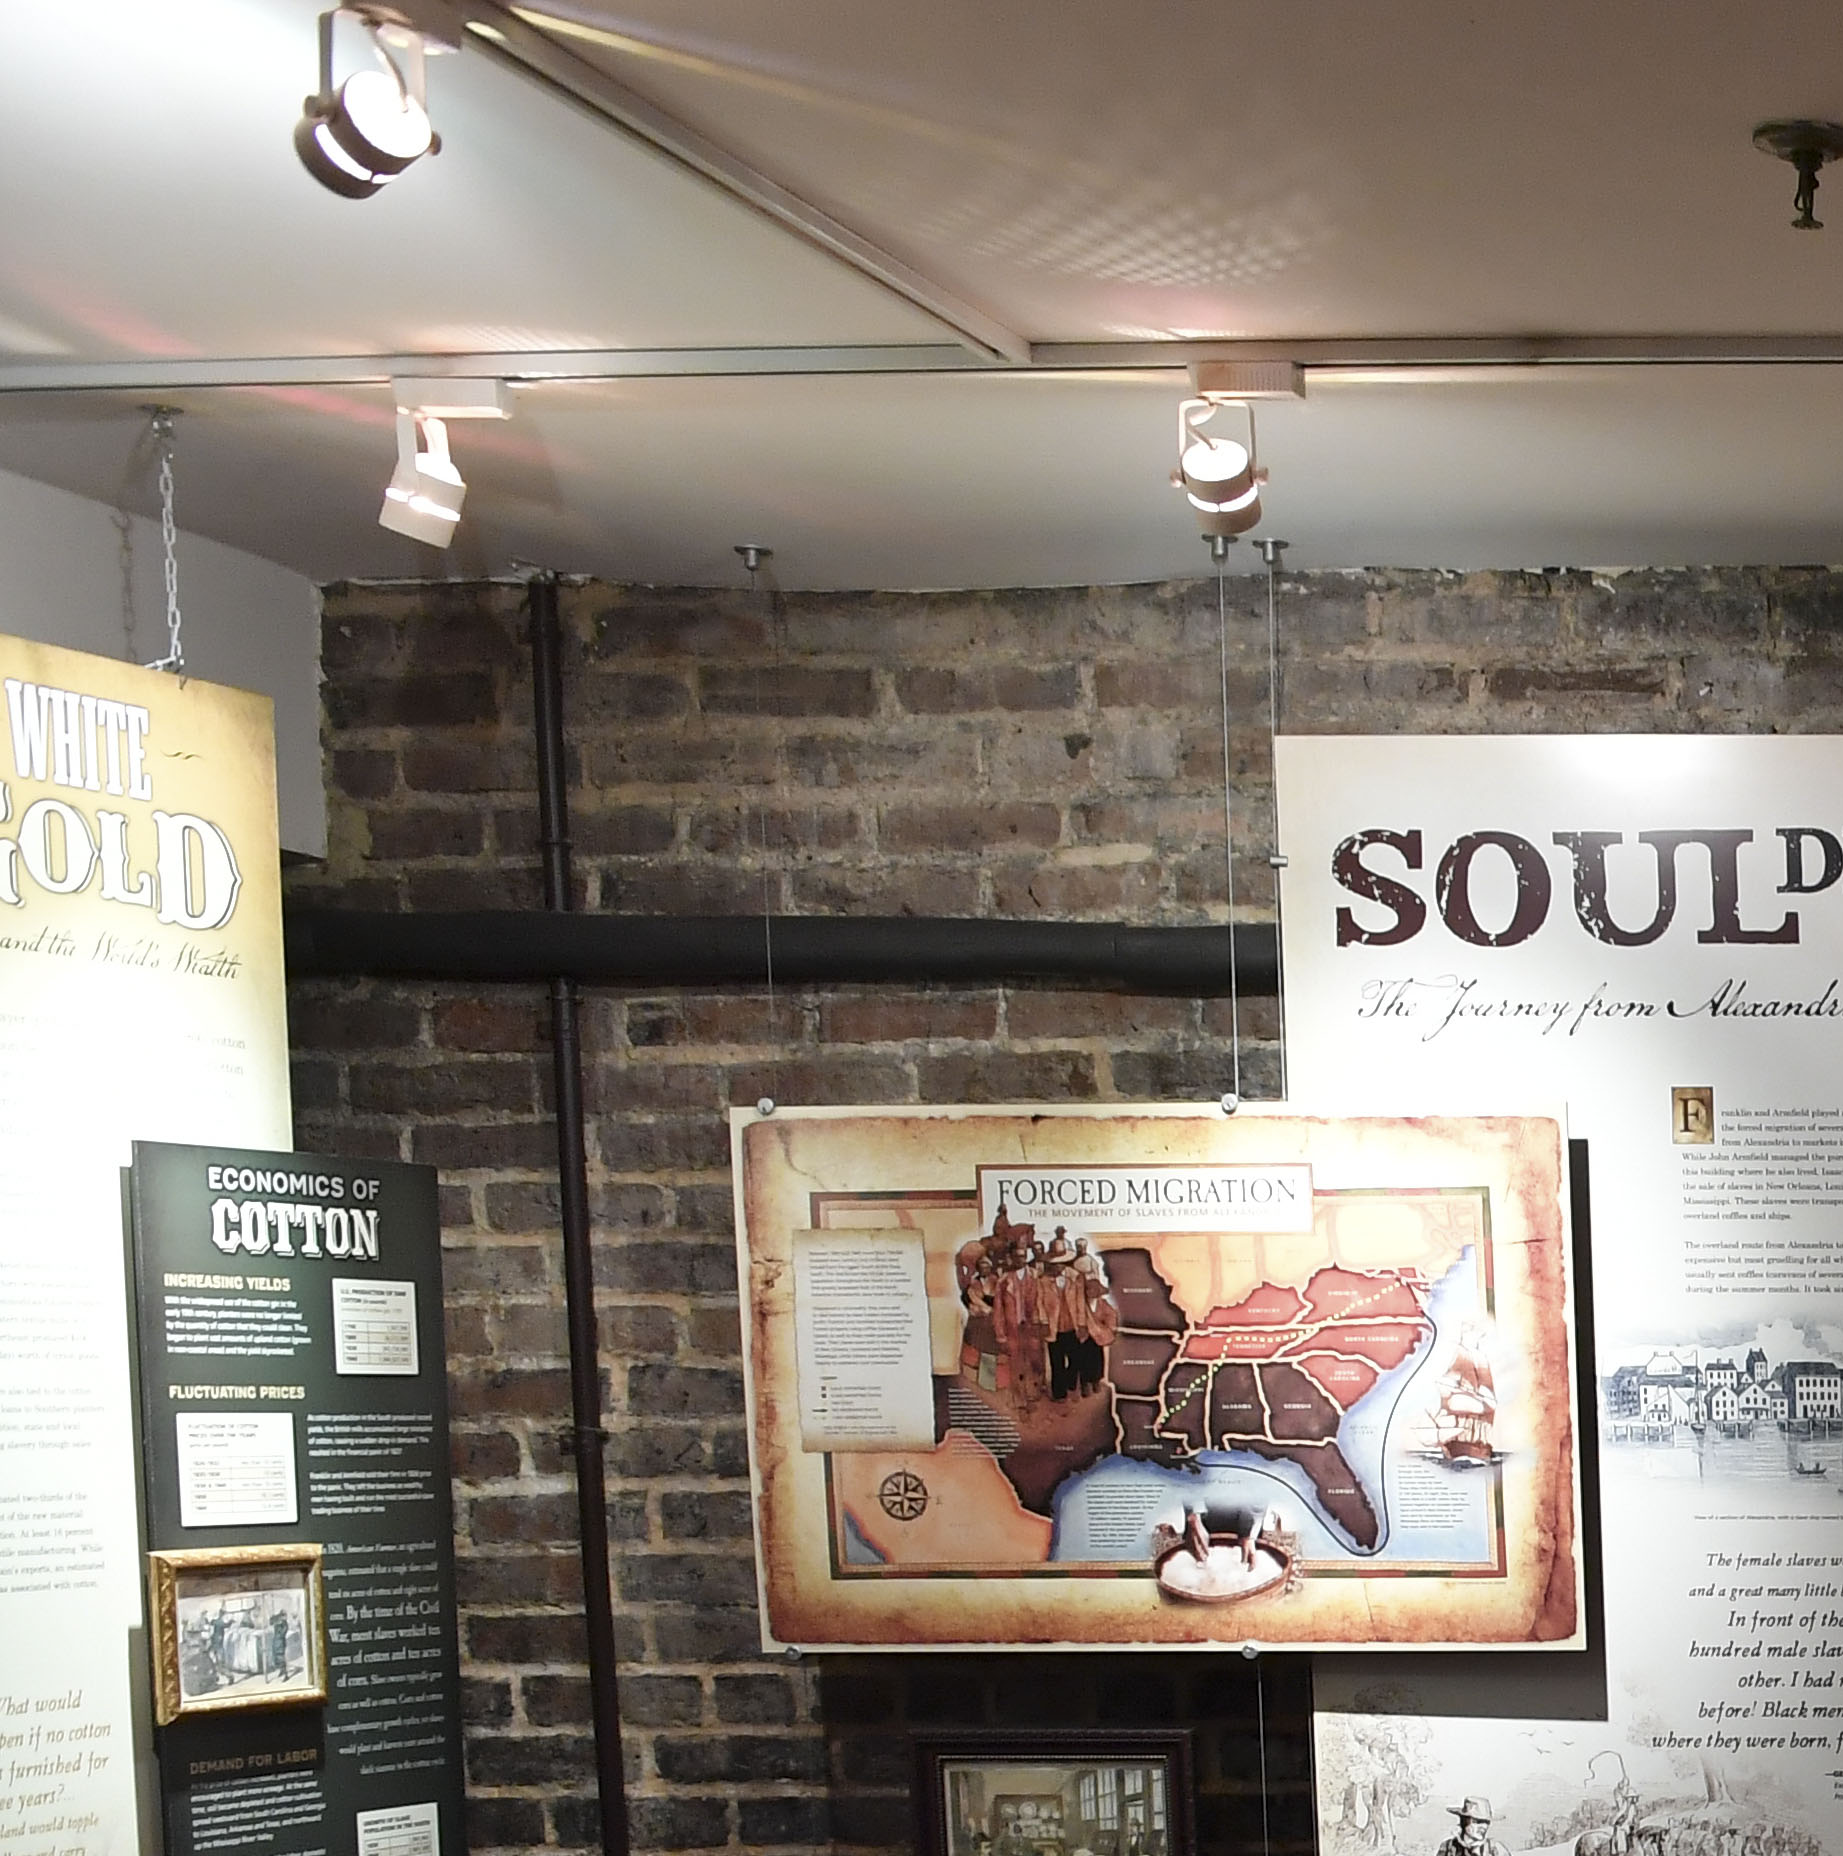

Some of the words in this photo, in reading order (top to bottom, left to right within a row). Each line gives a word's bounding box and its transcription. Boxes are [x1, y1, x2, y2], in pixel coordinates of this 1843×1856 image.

[4, 677, 153, 802] WHITE
[1330, 828, 1801, 950] SOUL
[1357, 977, 1418, 1022] The
[1423, 975, 1572, 1041] Journey
[1577, 983, 1662, 1038] from
[209, 1167, 344, 1198] ECONOMICS
[353, 1179, 379, 1200] OF
[997, 1179, 1116, 1205] FORCED
[1126, 1179, 1294, 1204] MIGRATION
[1028, 1207, 1050, 1217] THE
[1052, 1207, 1114, 1218] MOVEMENT
[1118, 1208, 1132, 1218] OF
[1135, 1208, 1174, 1218] SLAVES
[1177, 1208, 1209, 1218] FROM
[211, 1198, 380, 1260] COTTON
[164, 1273, 243, 1289] INCREASING
[246, 1277, 291, 1291] YIELDS
[169, 1385, 256, 1399] FLUCTUATING
[260, 1386, 305, 1399] PRICES
[1689, 1640, 1763, 1658] hundred
[1767, 1640, 1807, 1657] male
[1738, 1670, 1785, 1688] other.
[1790, 1671, 1799, 1687] I
[1803, 1670, 1835, 1687] had
[190, 1758, 244, 1775] DEMAND
[246, 1754, 272, 1767] FOR
[277, 1749, 317, 1764] LABOR
